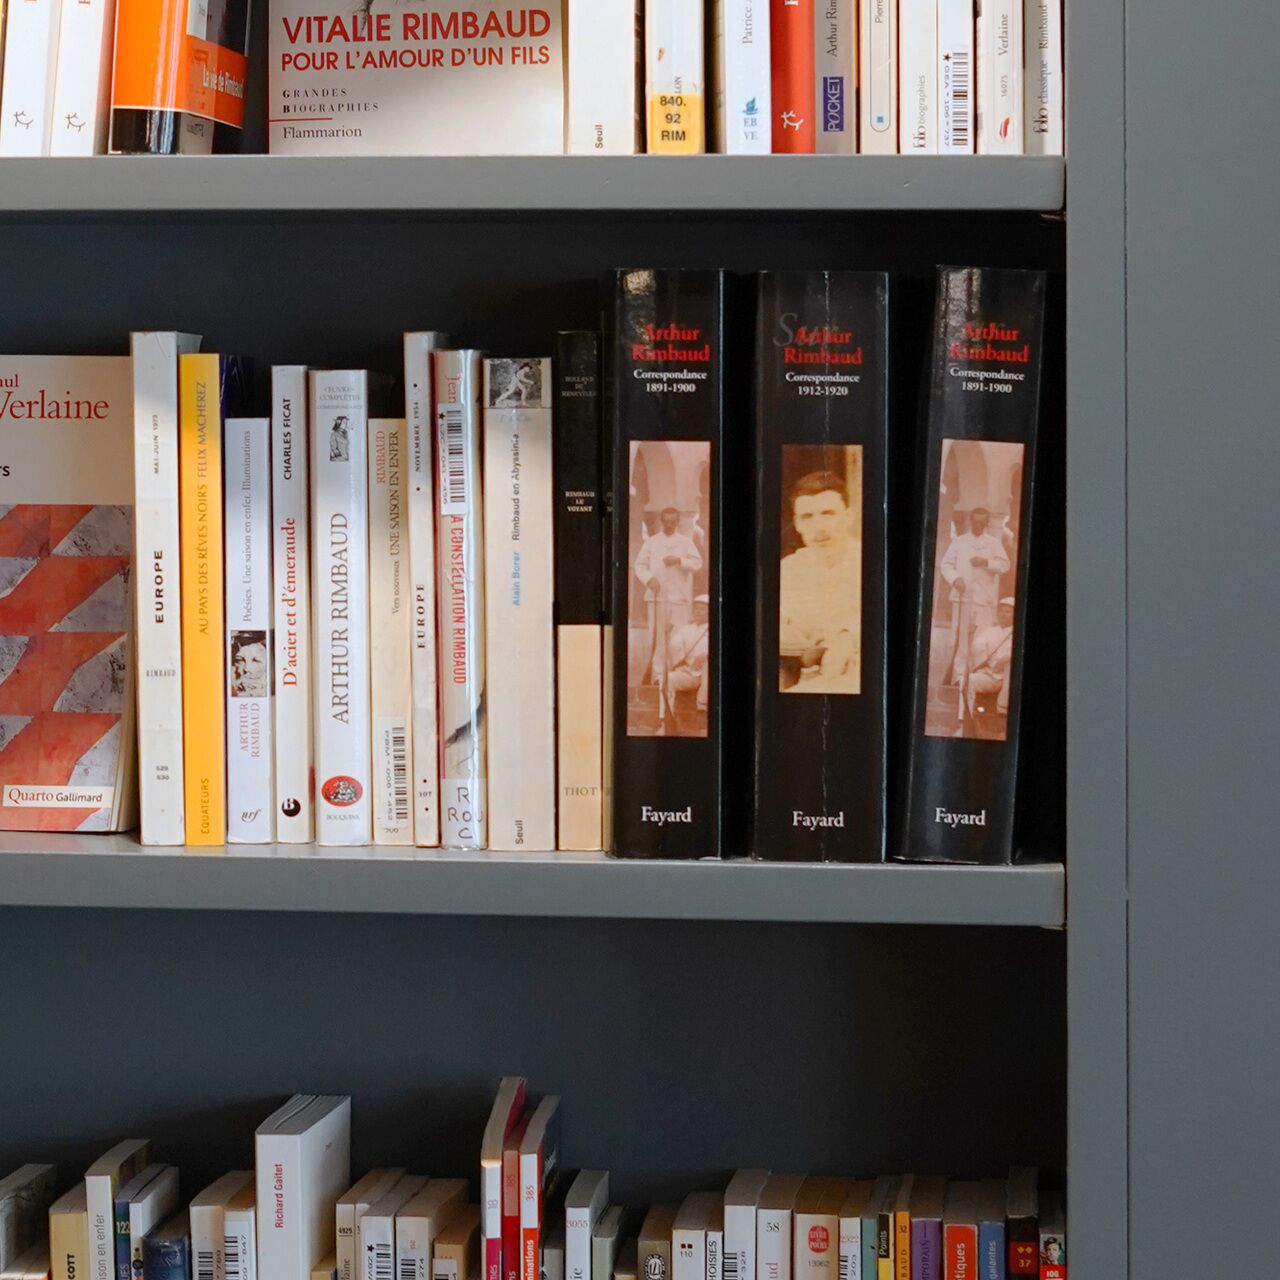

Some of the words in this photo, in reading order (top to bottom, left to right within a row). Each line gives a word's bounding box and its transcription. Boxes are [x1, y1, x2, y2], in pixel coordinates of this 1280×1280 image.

[282, 14, 392, 45] VITALIE
[403, 9, 551, 42] RIMBAUD
[826, 23, 837, 57] Arthur
[281, 52, 337, 71] POUR
[345, 50, 443, 70] L'AMOUR
[452, 48, 506, 67] D'UN
[512, 46, 550, 65] FILS
[282, 88, 348, 98] GRANDES
[660, 95, 687, 107] 840.
[282, 102, 380, 113] BIOGRAPHIES
[825, 78, 841, 131] POCKET
[665, 113, 681, 125] 92
[282, 125, 363, 140] Flammarion
[661, 129, 686, 141] RIM
[643, 324, 699, 342] Arthur
[796, 327, 851, 344] Arthur
[631, 344, 710, 361] Rimbaud
[784, 348, 862, 365] Rimbaud
[634, 370, 707, 381] Correspondance
[786, 372, 859, 384] Correspondance
[950, 366, 1025, 381] Correspondance
[645, 383, 695, 393] 1891-1900
[798, 386, 848, 396] 1912-1920
[962, 382, 1012, 394] 1891-1900
[283, 397, 292, 430] FICAT
[284, 433, 292, 480] CHARLES
[376, 430, 385, 484] RIMBAUD
[389, 432, 399, 467] ENFER
[389, 470, 399, 485] EN
[389, 489, 399, 526] SAISON
[389, 529, 399, 555] UNE
[285, 517, 297, 608] d'émeraude
[331, 512, 348, 620] RIMBAUD
[452, 526, 466, 621] CONSTELLATION
[154, 550, 164, 624] EUROPE
[285, 614, 296, 632] et
[282, 635, 298, 687] D'acier
[453, 621, 466, 684] RIMBAUD
[329, 625, 349, 724] ARTHUR
[8, 788, 54, 805] Quarto
[56, 791, 102, 804] Gallimard
[641, 807, 692, 825] Fayard
[792, 811, 844, 829] Fayard
[935, 808, 986, 826] Fayard
[274, 1163, 284, 1192] Gaitet
[274, 1194, 284, 1229] Richard
